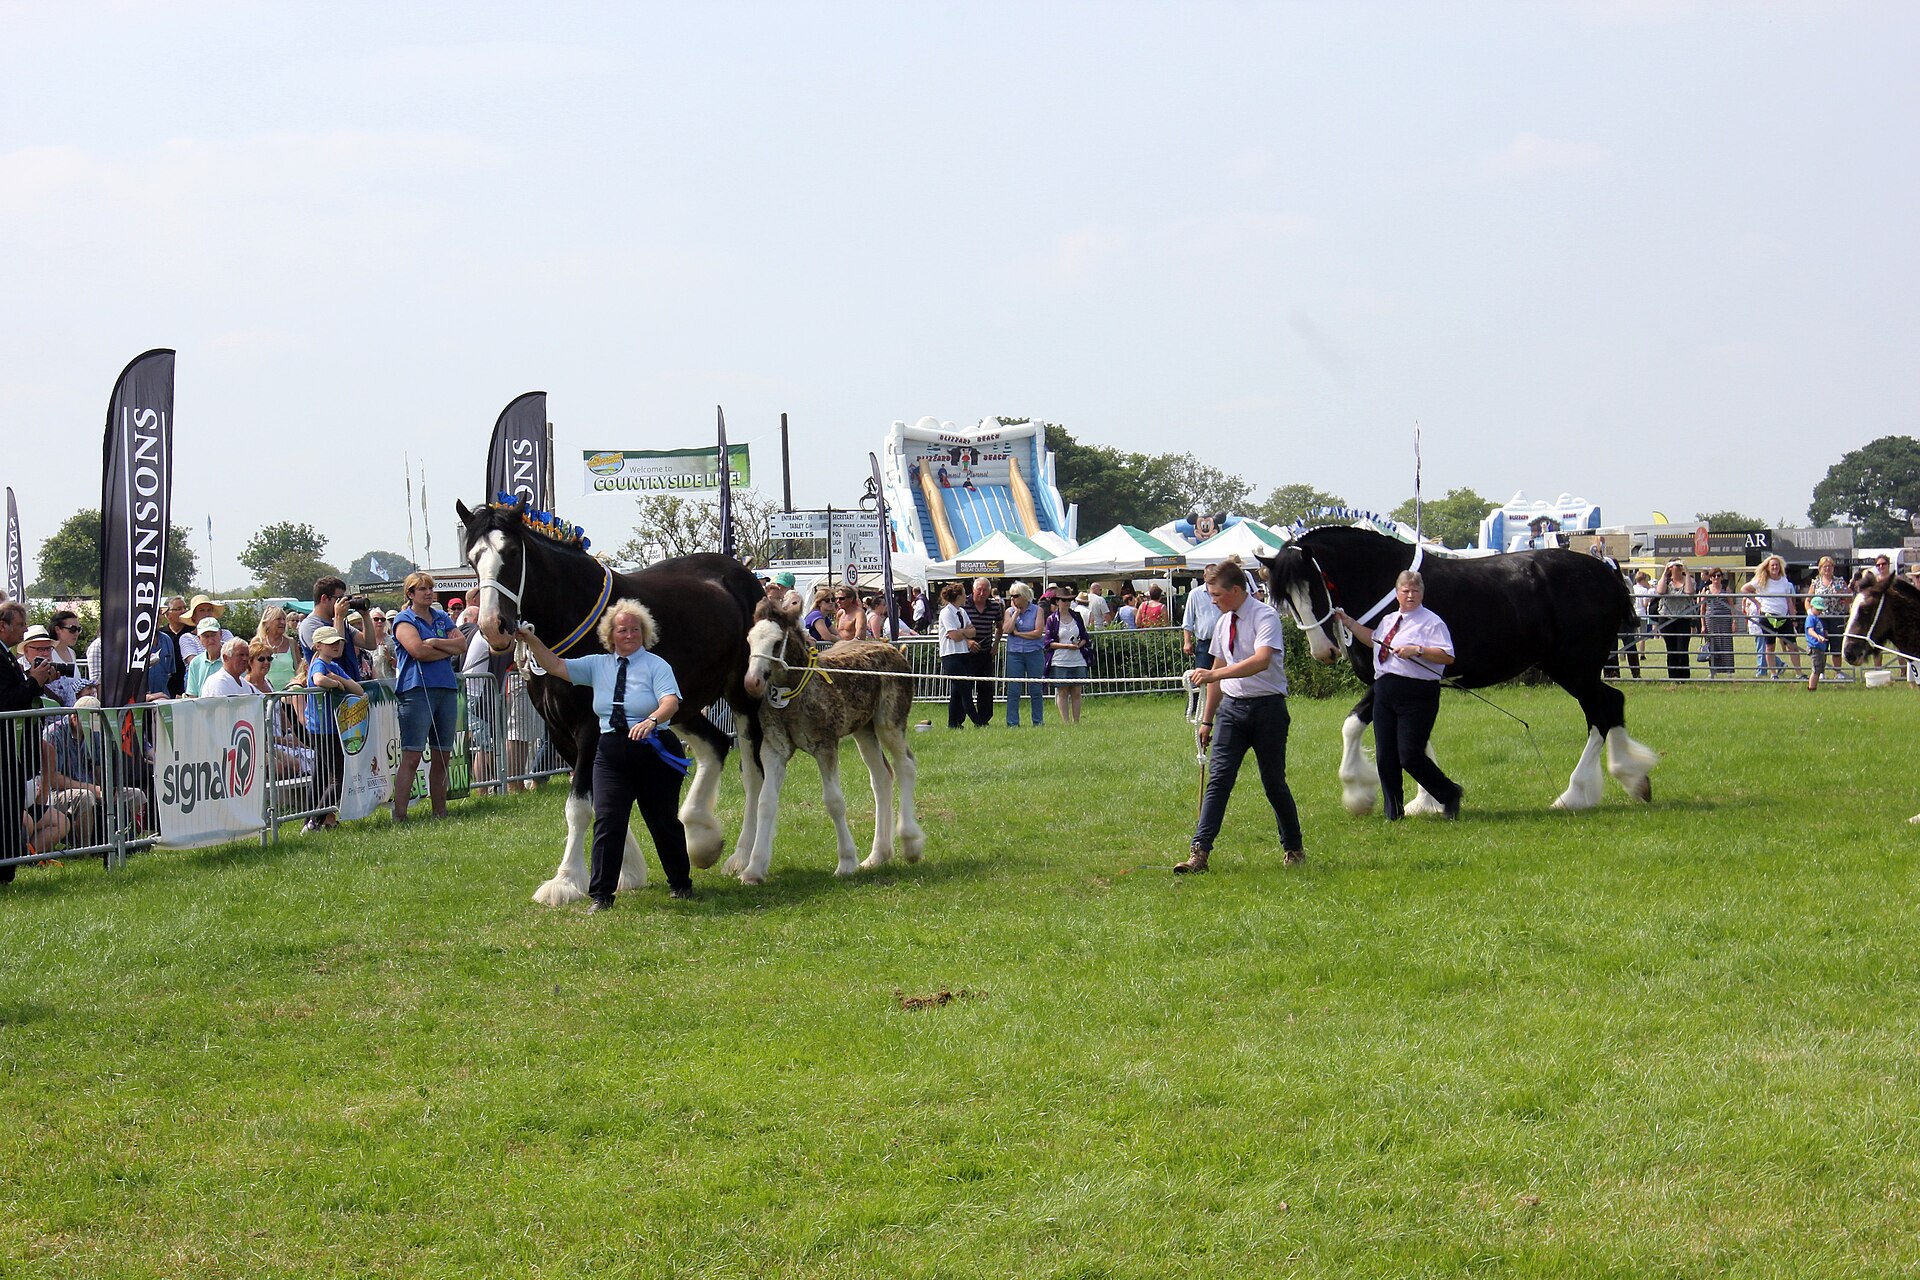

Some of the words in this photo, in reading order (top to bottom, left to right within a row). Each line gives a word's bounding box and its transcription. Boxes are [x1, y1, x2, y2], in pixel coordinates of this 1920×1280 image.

[977, 433, 1000, 442] BEACH
[629, 466, 663, 474] Welcome
[594, 473, 702, 491] COUNTRYSIDE
[705, 471, 741, 487] LIE!
[129, 407, 159, 673] ROBINSONS
[1793, 532, 1814, 548] THE
[1817, 531, 1837, 547] BAR
[849, 541, 857, 559] K
[848, 570, 856, 580] 15
